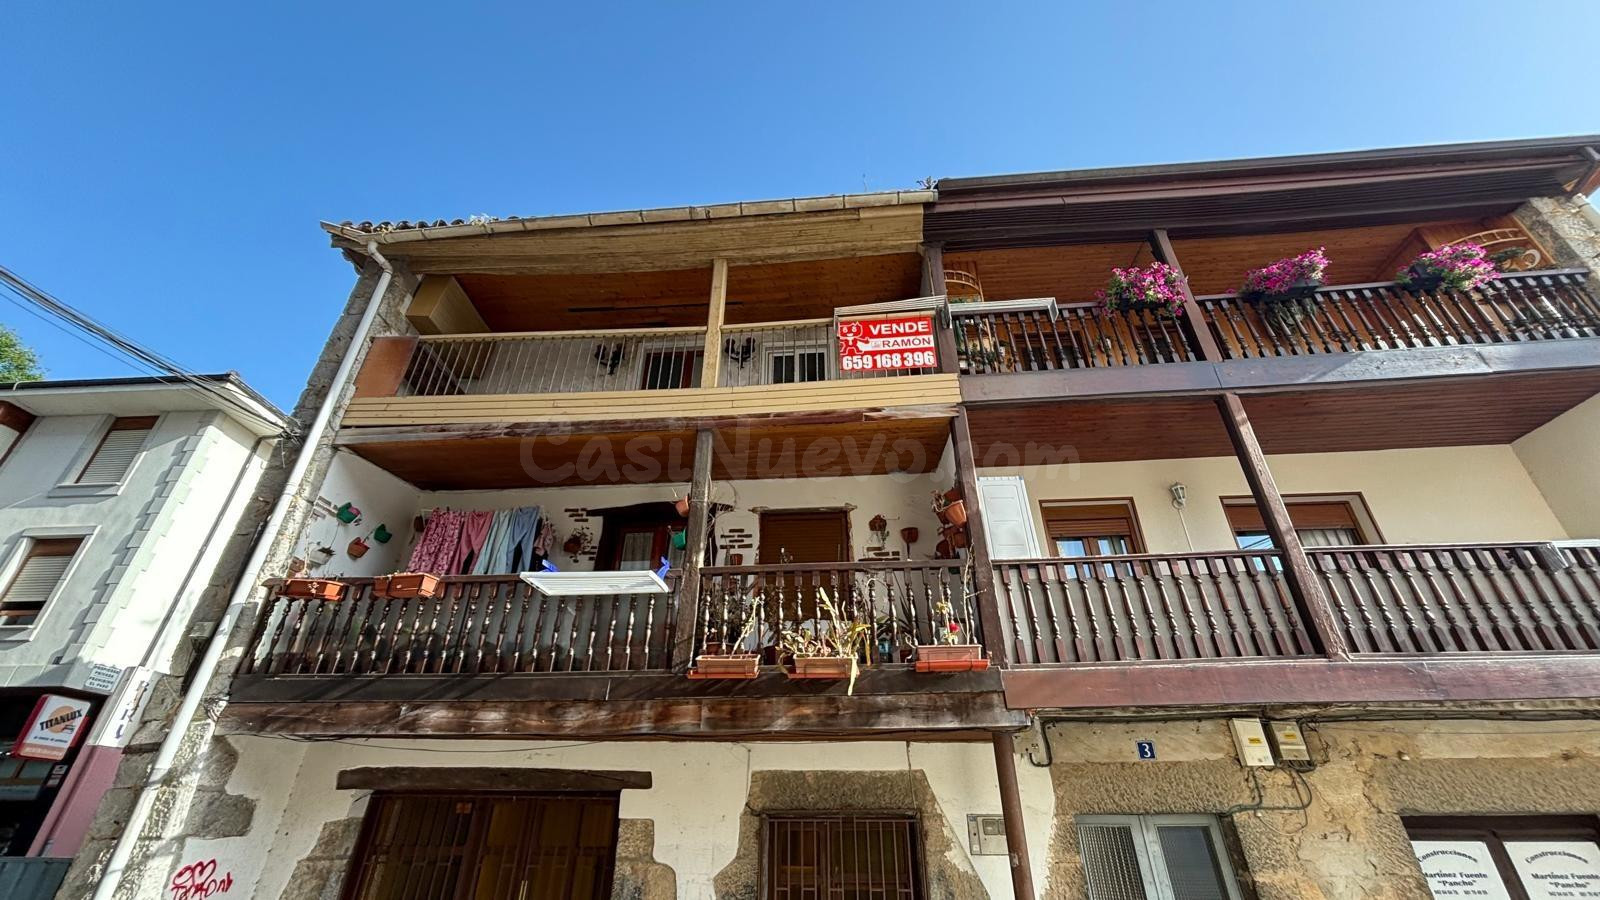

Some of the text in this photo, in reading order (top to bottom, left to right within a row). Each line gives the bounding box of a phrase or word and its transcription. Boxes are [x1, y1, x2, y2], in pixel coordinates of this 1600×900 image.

[869, 321, 929, 335] VENDE
[842, 351, 934, 370] 659 168 396
[40, 709, 82, 731] TITANLUX
[1142, 743, 1151, 758] 3
